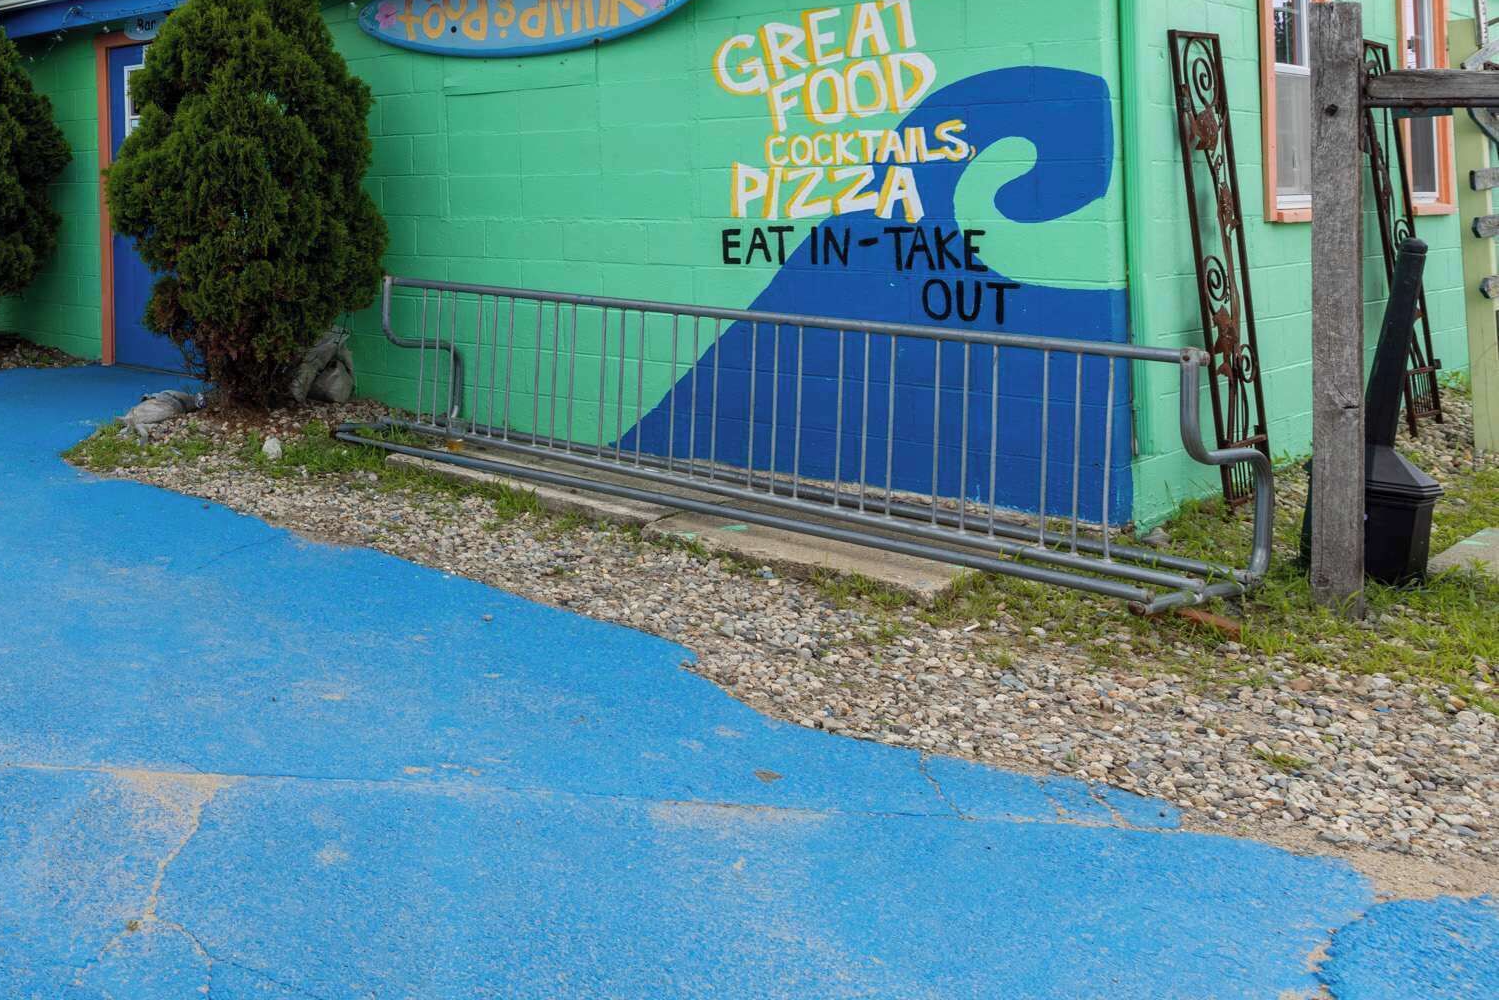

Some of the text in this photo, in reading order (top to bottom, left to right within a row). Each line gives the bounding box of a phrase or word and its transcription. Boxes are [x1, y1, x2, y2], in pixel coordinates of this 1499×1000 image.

[768, 52, 937, 132] FOOD
[731, 161, 925, 223] PIZZA
[721, 226, 794, 265] EAT
[922, 278, 1020, 325] OUT
